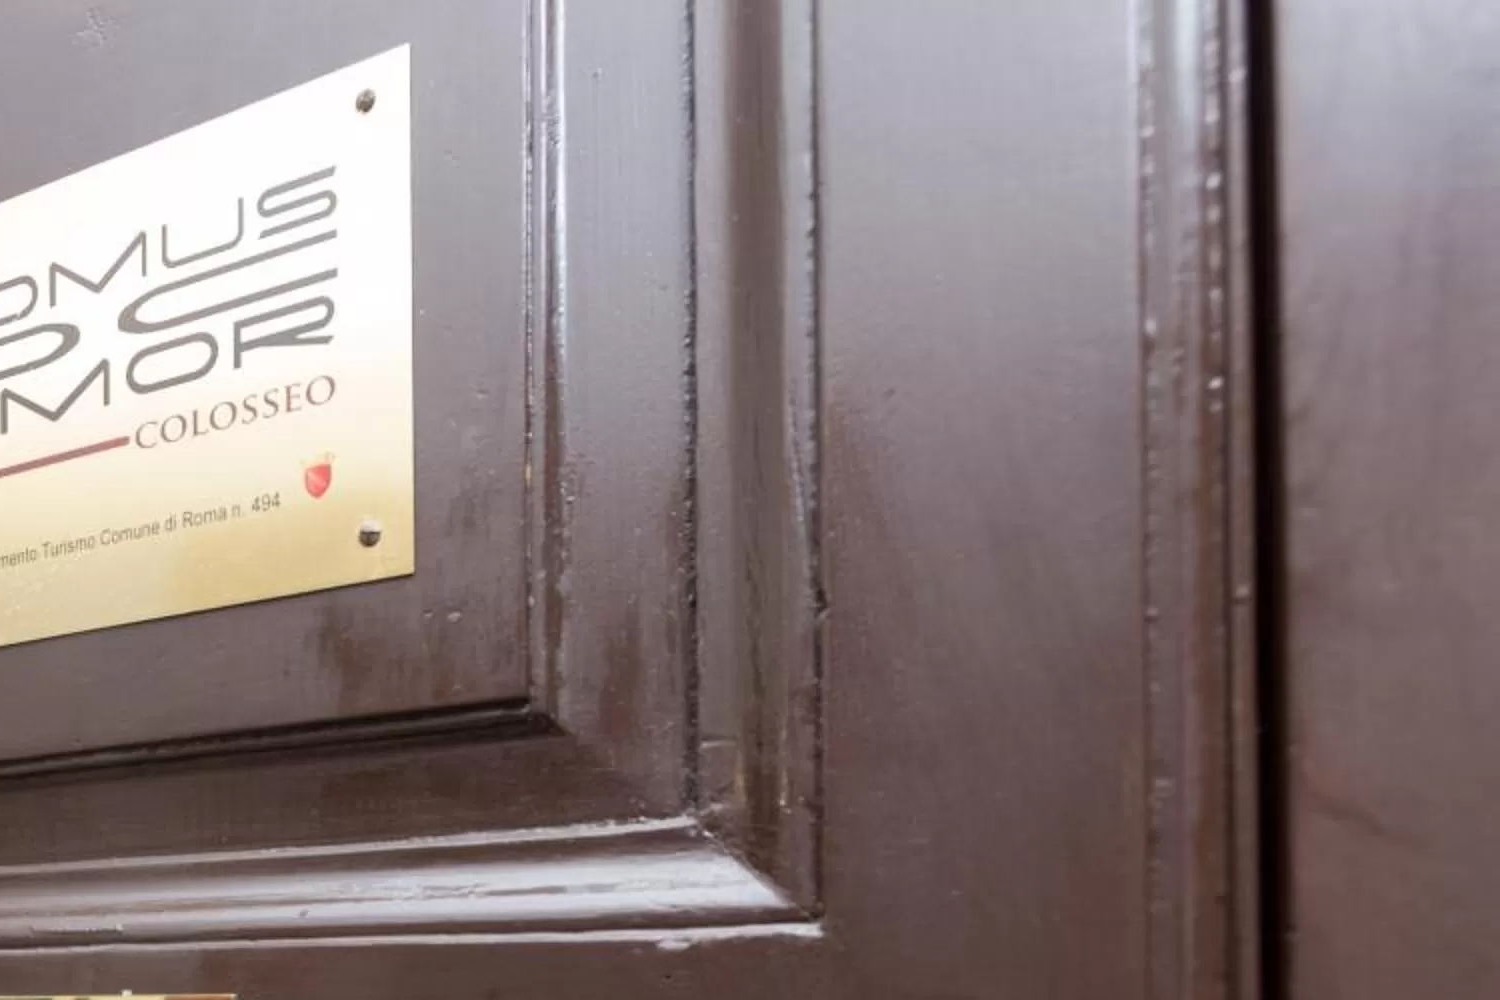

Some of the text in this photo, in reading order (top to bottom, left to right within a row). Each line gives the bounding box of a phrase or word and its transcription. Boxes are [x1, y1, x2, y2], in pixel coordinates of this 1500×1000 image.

[135, 375, 336, 449] COLOSSEO
[42, 535, 96, 560] Turismo
[100, 521, 160, 546] Comune
[165, 512, 177, 533] di
[182, 506, 228, 528] Roma
[232, 503, 246, 517] n.
[251, 492, 281, 512] 494
